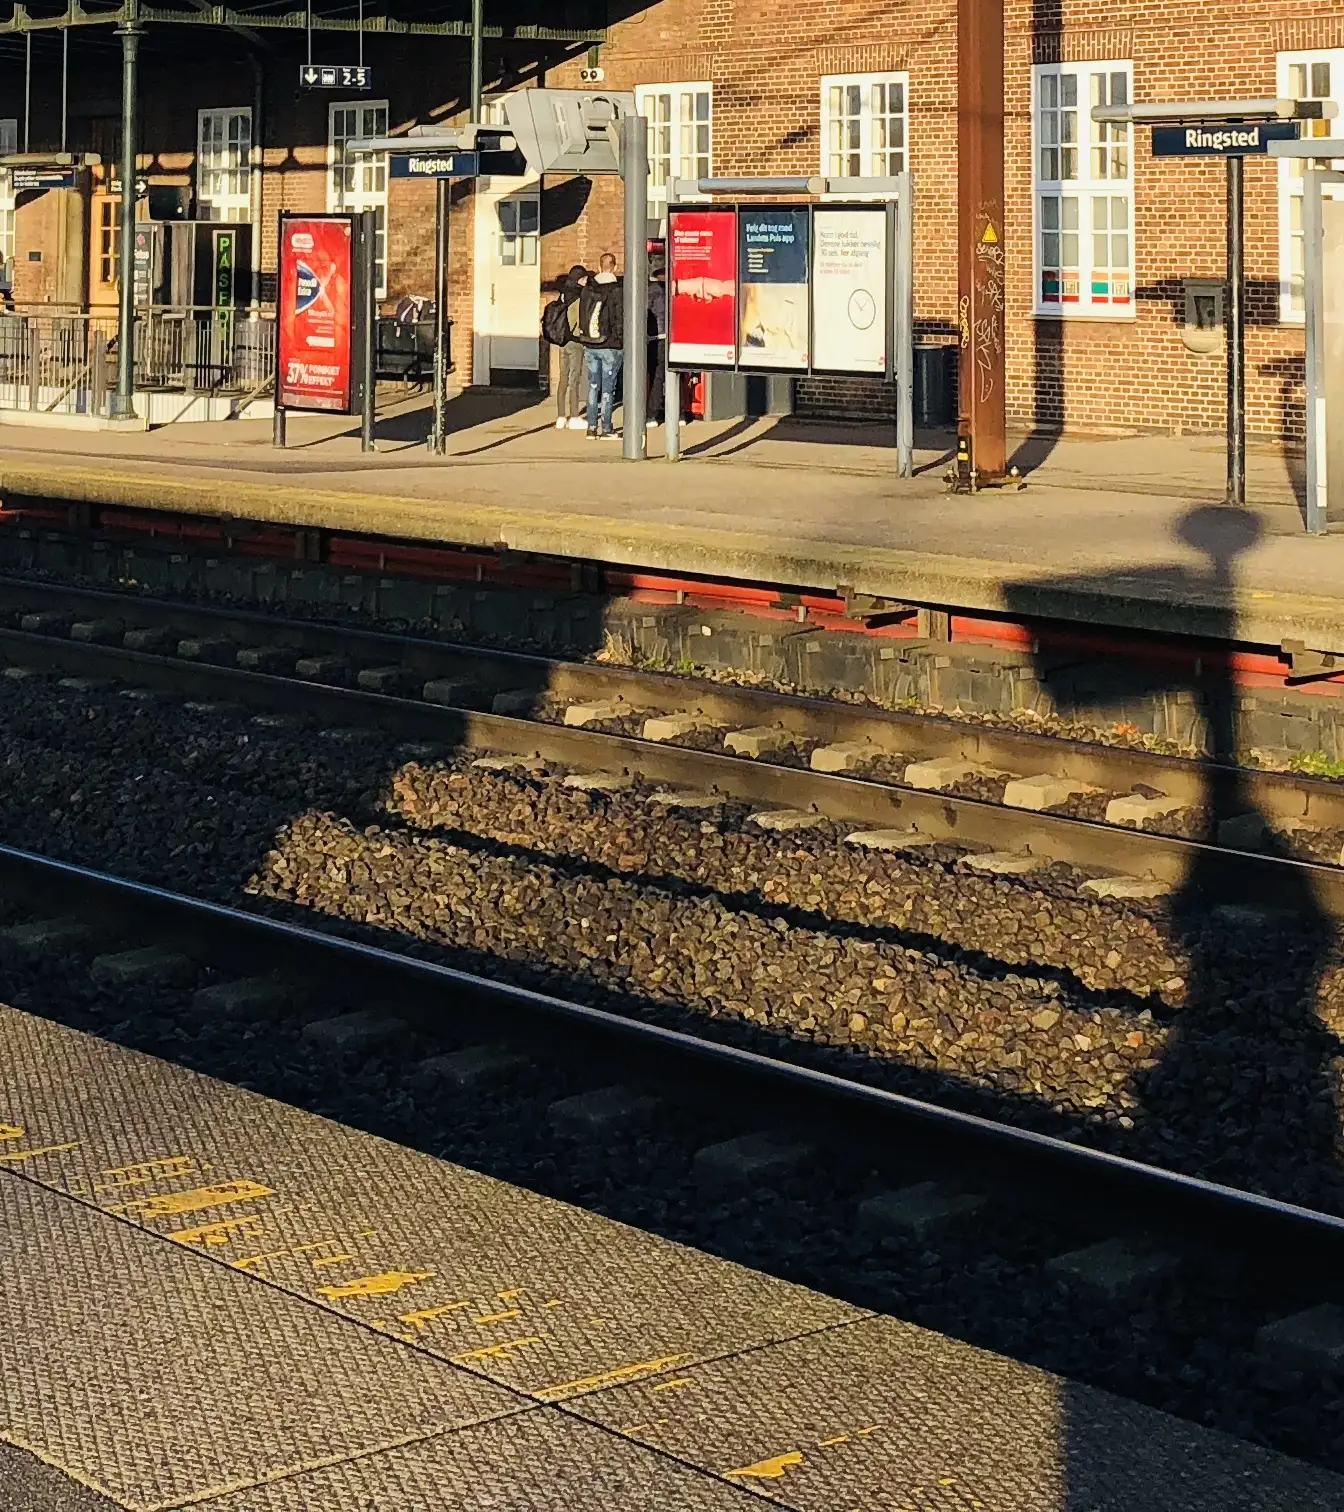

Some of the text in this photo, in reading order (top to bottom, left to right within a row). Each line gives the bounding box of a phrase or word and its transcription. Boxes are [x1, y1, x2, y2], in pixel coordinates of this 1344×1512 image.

[343, 72, 366, 86] 2-5
[1185, 127, 1260, 151] Ringsted
[408, 155, 454, 175] Ringsted
[287, 362, 309, 385] 37%
